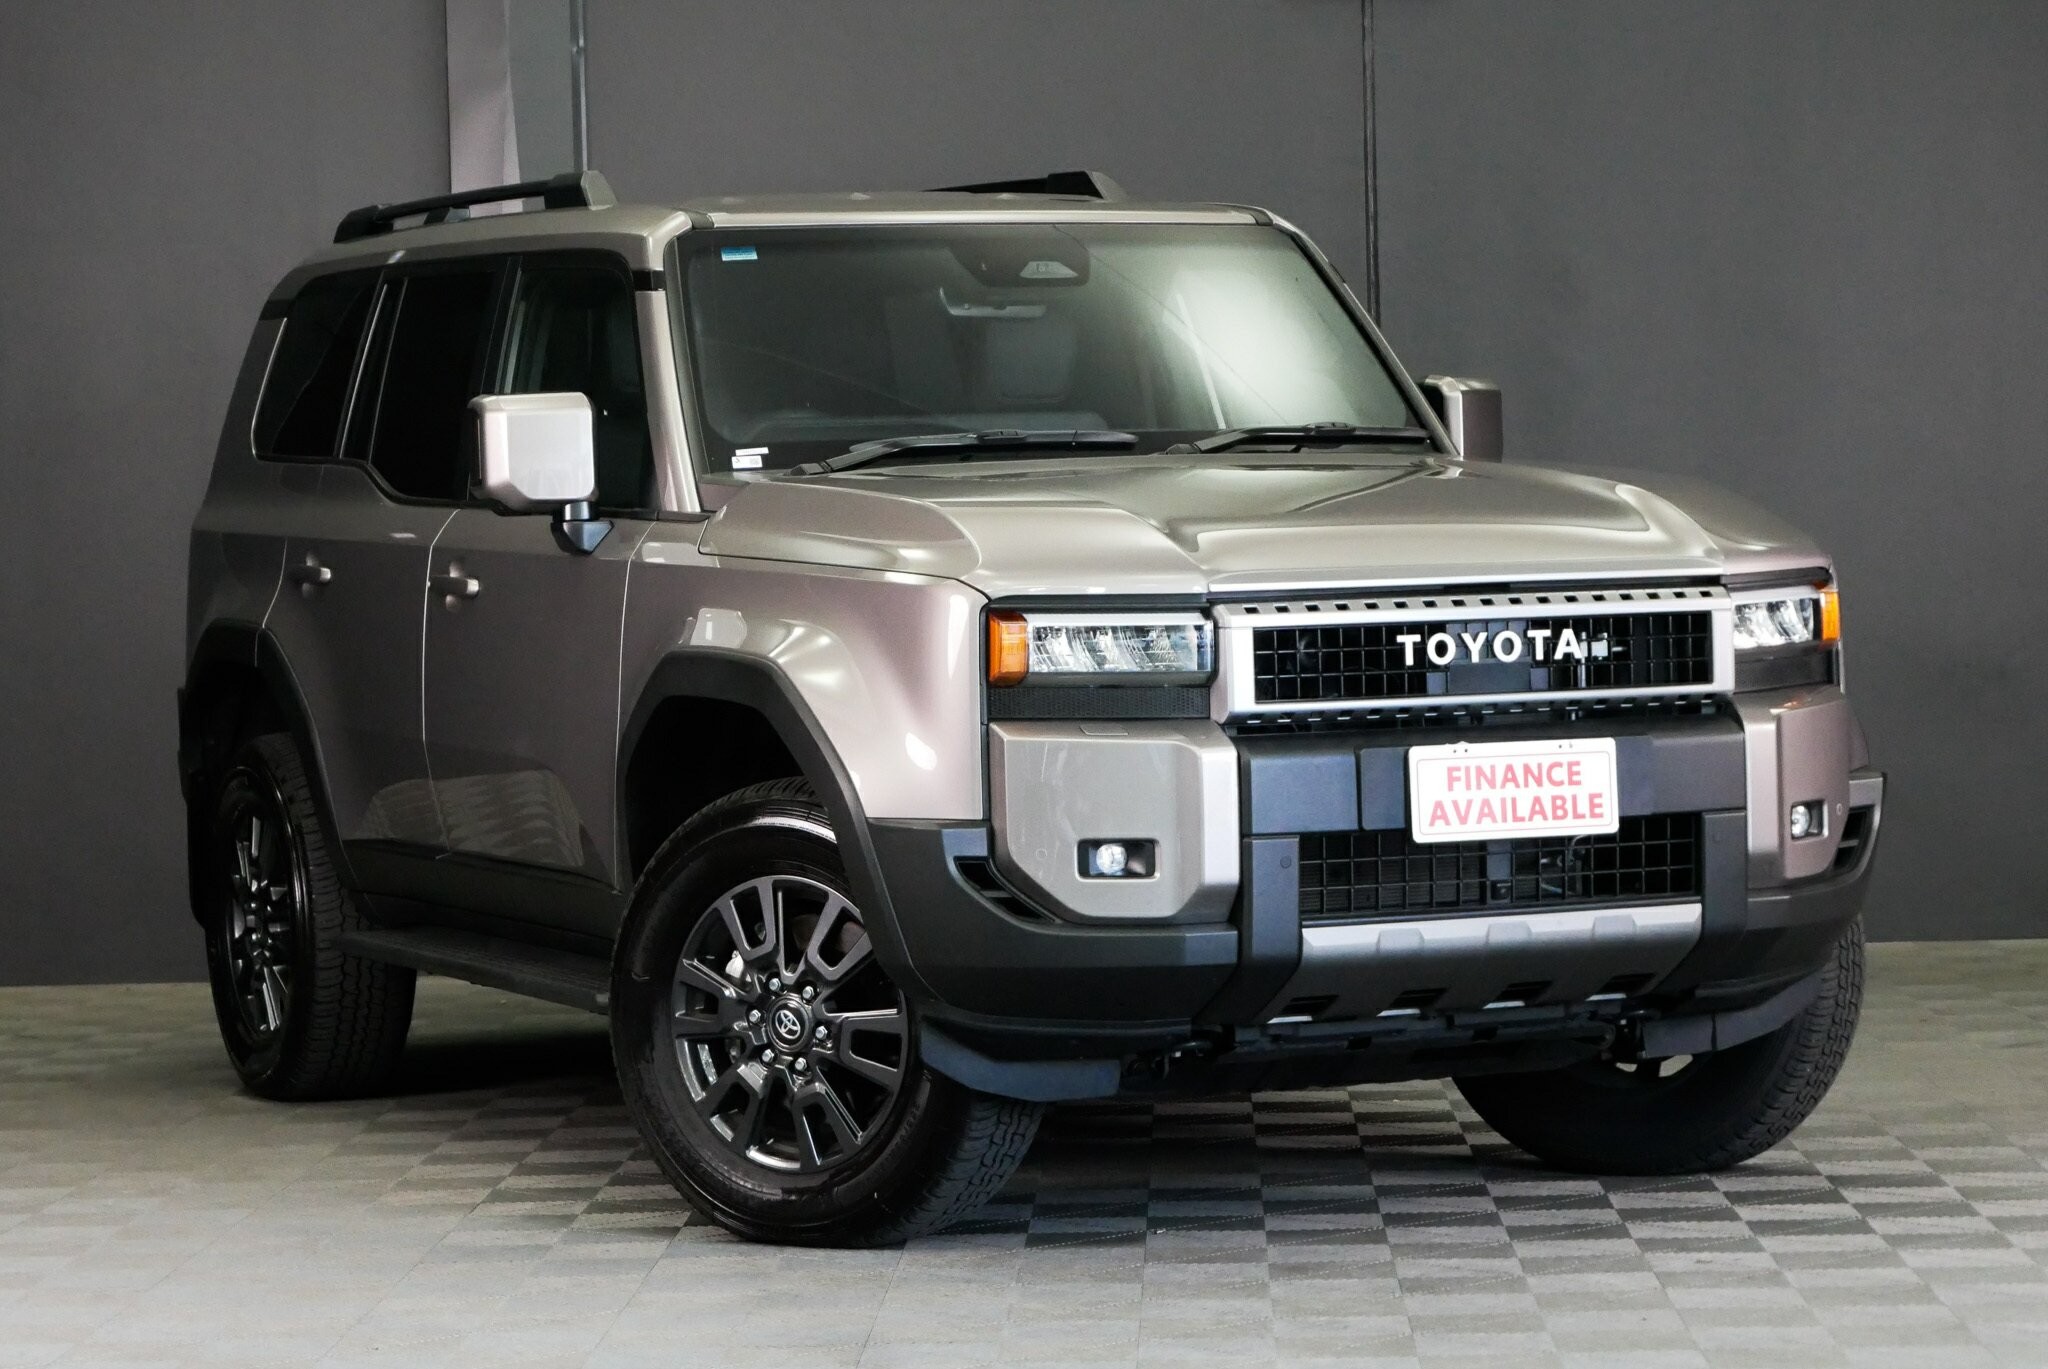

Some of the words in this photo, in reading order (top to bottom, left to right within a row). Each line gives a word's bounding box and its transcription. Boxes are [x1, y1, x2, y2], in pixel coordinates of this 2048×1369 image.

[1396, 628, 1583, 666] TOYOTA
[1447, 761, 1582, 791] FINANCE
[1429, 793, 1604, 827] AVAILABLE
